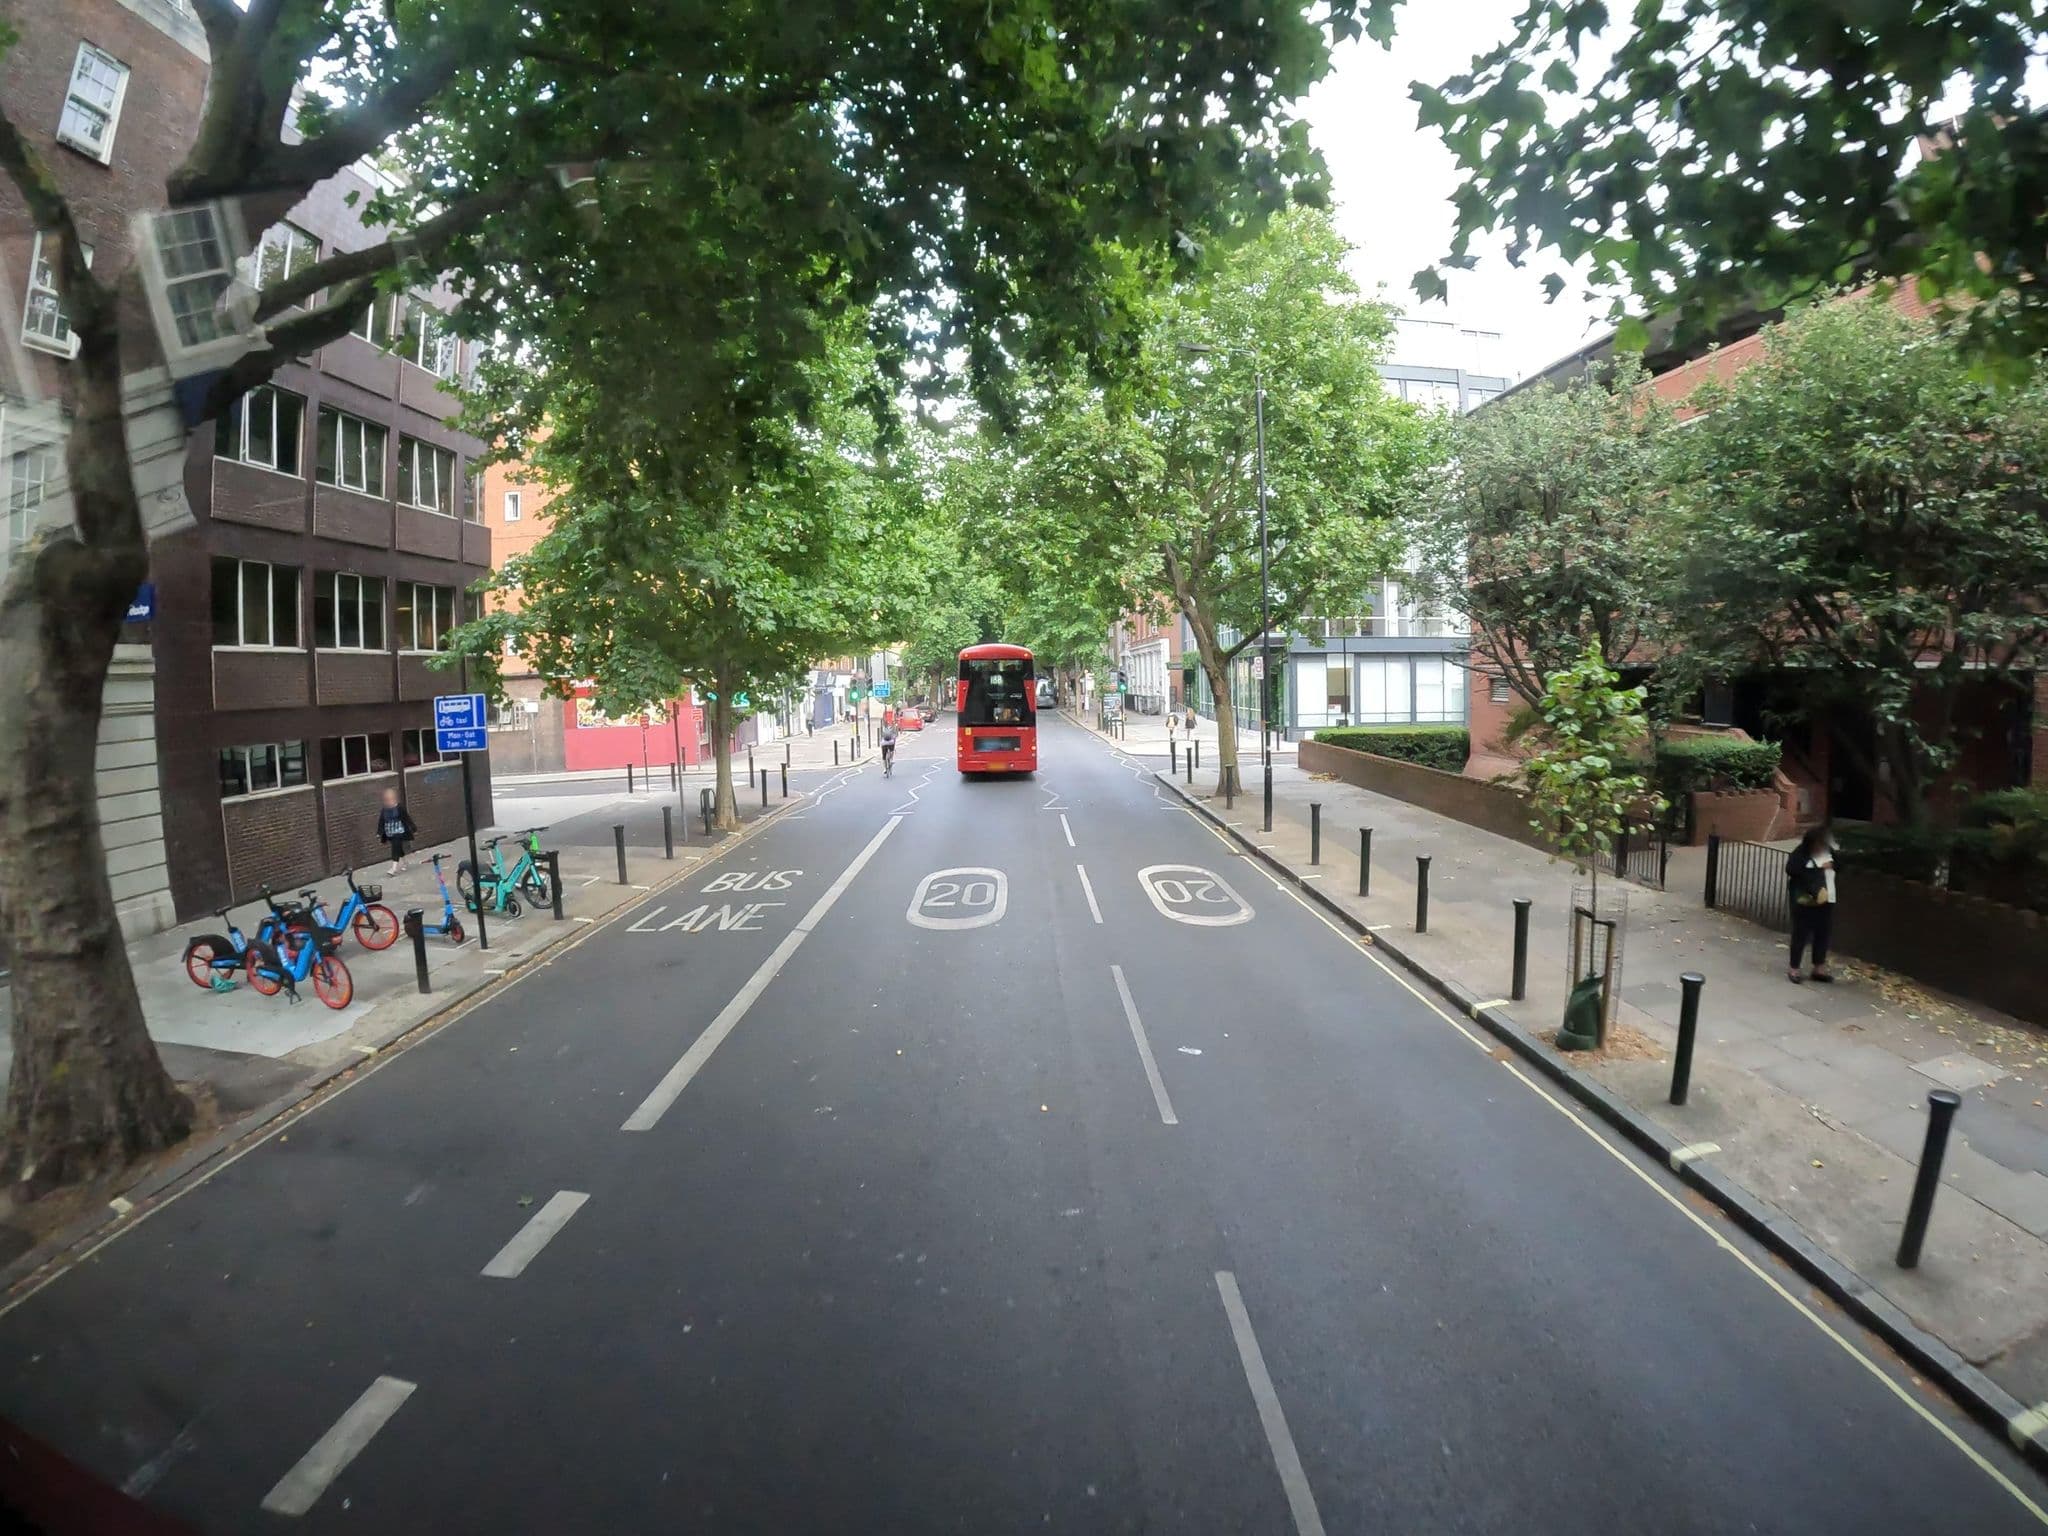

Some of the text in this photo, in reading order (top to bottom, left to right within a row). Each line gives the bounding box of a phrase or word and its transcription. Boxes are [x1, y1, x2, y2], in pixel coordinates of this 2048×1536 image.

[455, 716, 468, 724] taxi
[700, 870, 803, 893] BUS
[1153, 879, 1230, 903] 20
[923, 882, 995, 907] 20
[625, 902, 787, 933] LANE
